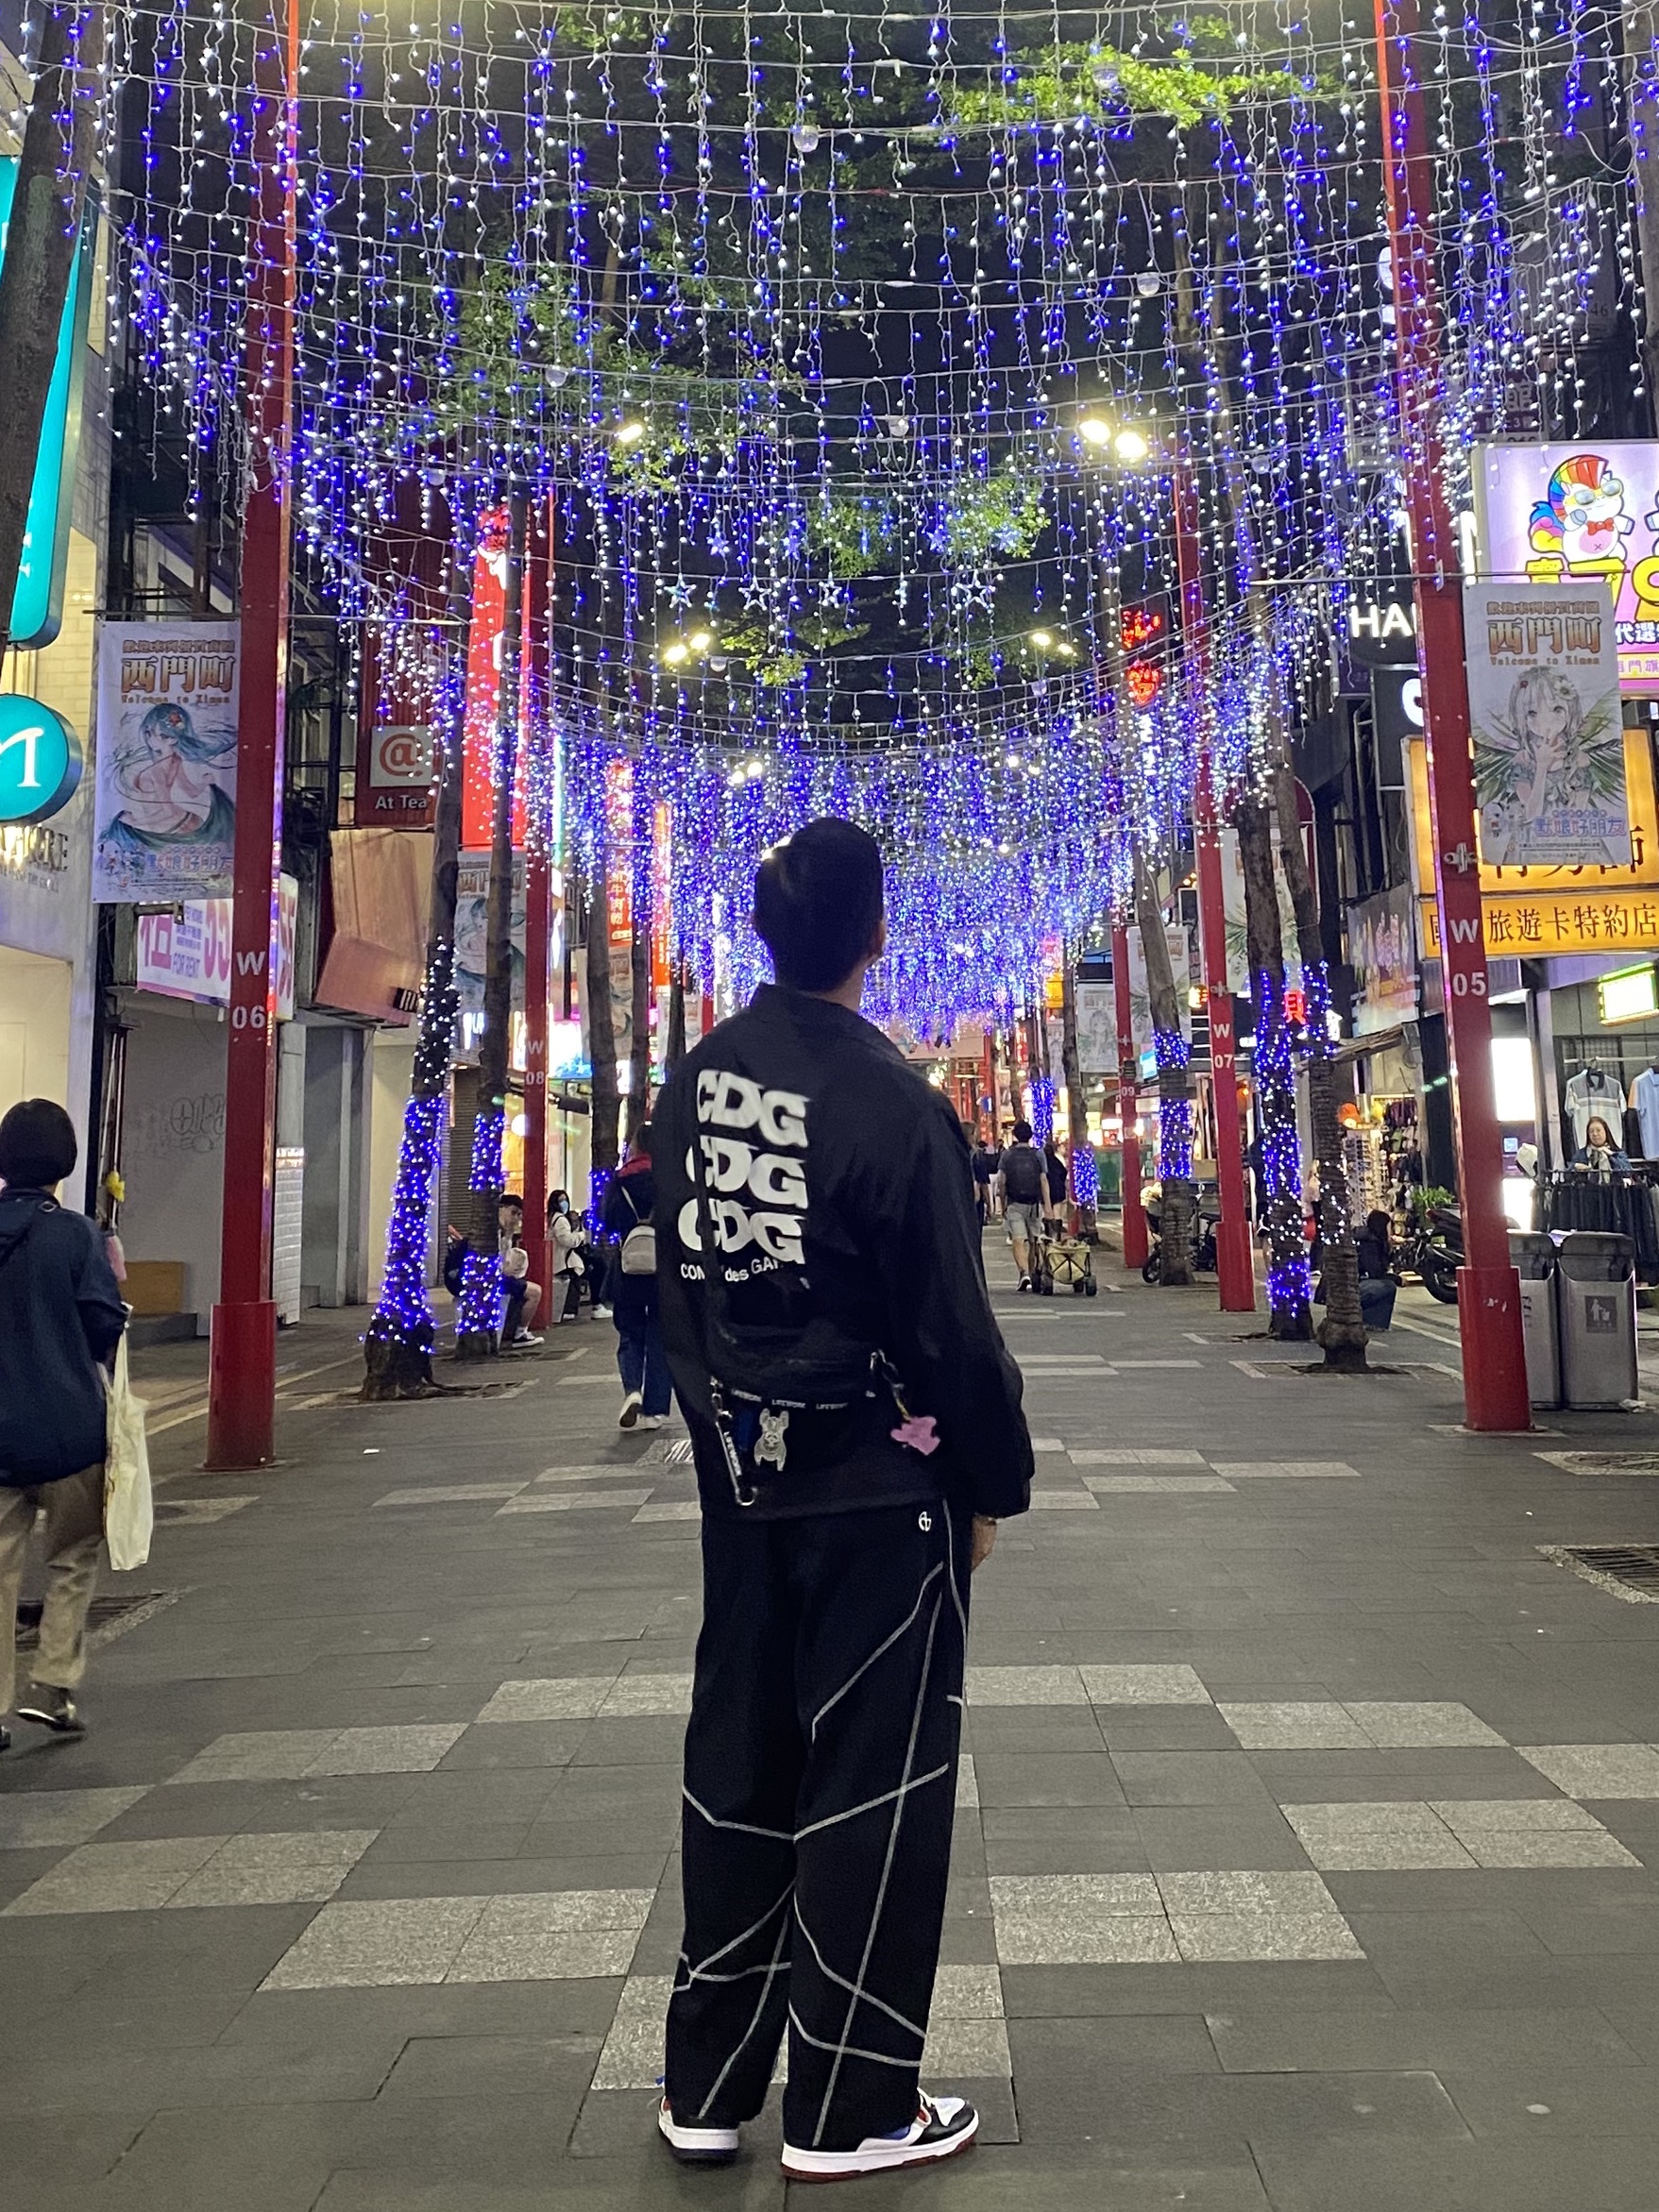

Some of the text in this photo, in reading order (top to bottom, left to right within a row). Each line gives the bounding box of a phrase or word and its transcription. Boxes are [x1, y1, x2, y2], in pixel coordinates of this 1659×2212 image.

[1486, 616, 1602, 654] 西門町
[1615, 621, 1659, 645] 代選
[1490, 655, 1600, 666] Welcome to Ximen
[121, 656, 235, 693] 西門町
[177, 696, 189, 704] to
[375, 795, 428, 809] At Tea
[1430, 903, 1657, 946] 旅遊卡特約店
[1449, 919, 1478, 943] W
[236, 951, 265, 976] W
[1452, 971, 1486, 997] 05
[232, 1005, 265, 1029] 06
[1212, 1023, 1230, 1038] W
[528, 1041, 543, 1054] W
[1214, 1055, 1233, 1069] 07
[526, 1072, 545, 1086] 08
[1121, 1086, 1135, 1096] 09
[697, 1069, 809, 1147] CDG
[724, 1267, 749, 1282] des
